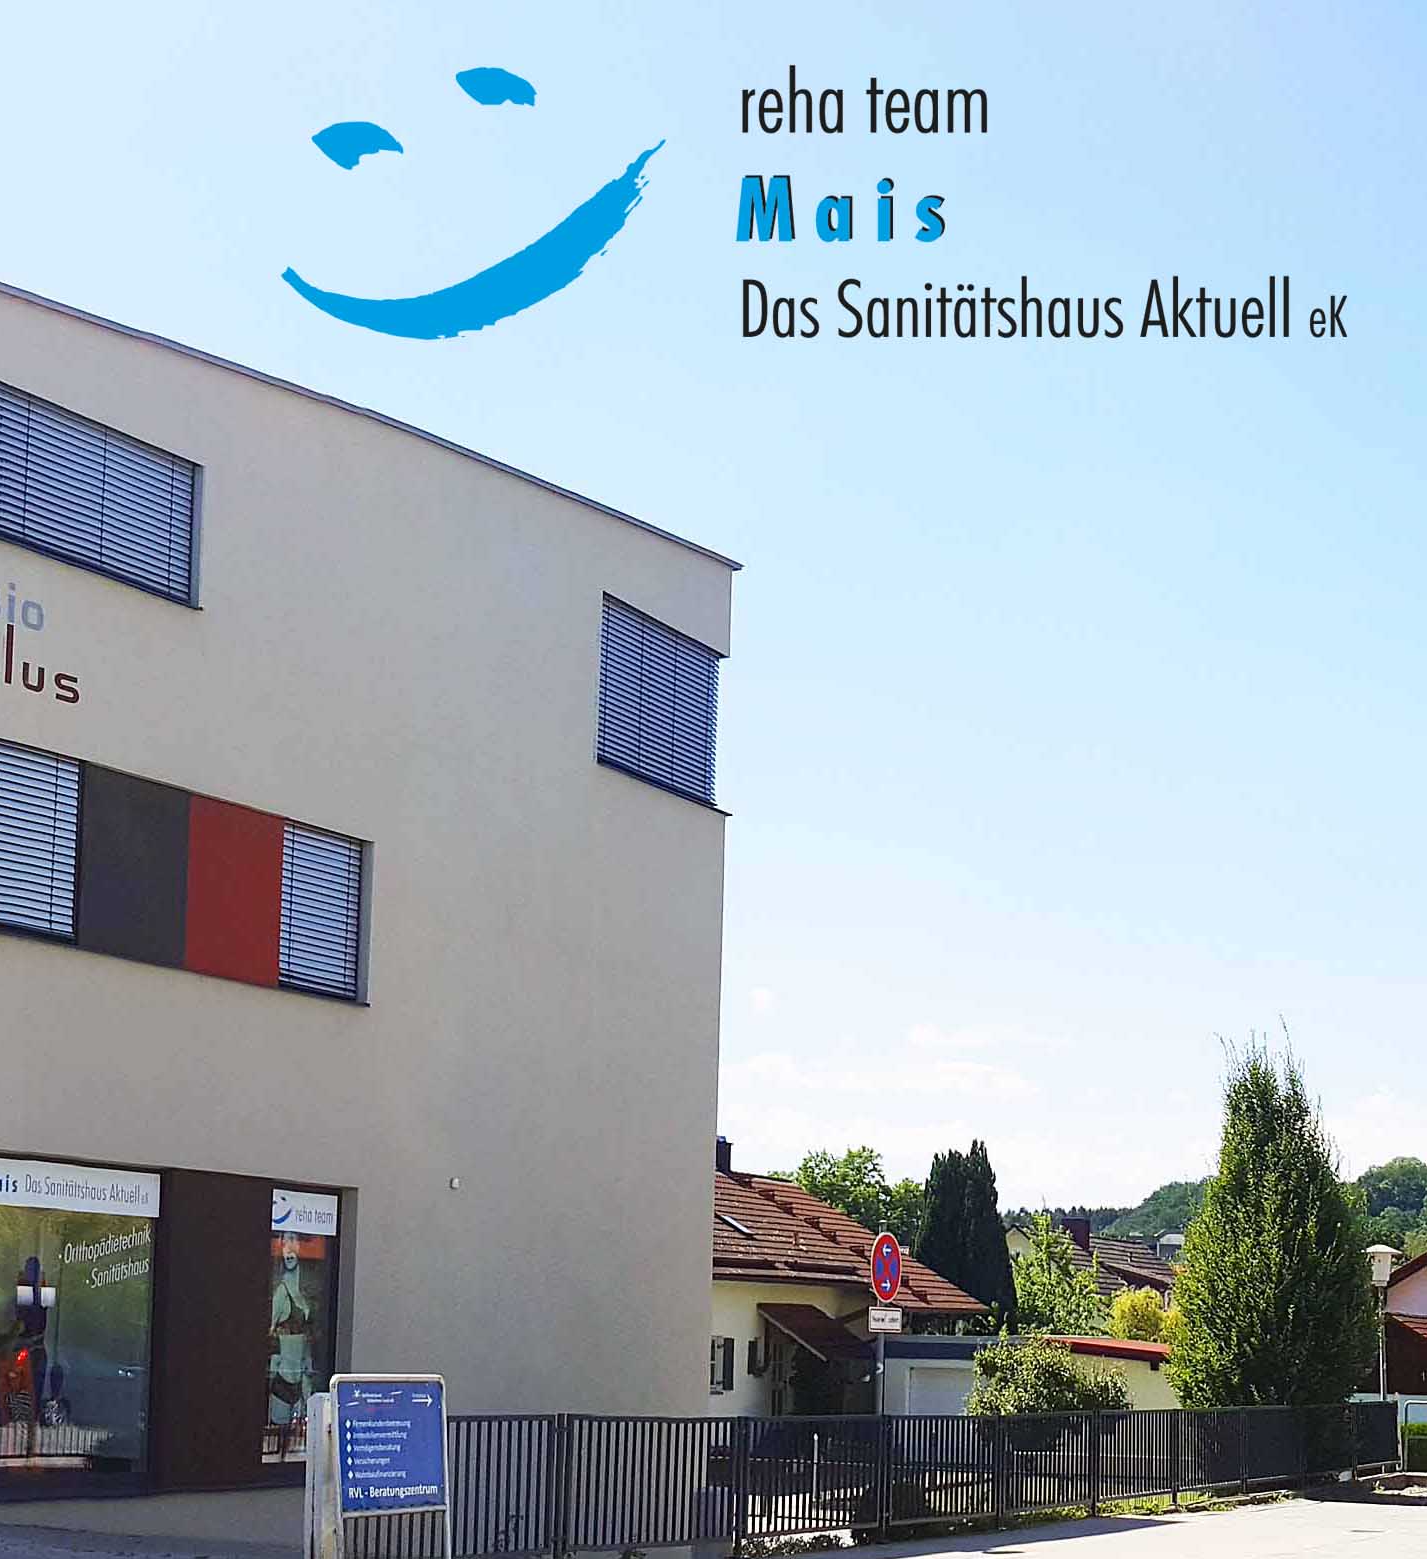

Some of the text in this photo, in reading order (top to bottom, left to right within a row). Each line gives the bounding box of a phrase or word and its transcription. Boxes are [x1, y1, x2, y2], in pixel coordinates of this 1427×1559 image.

[25, 1174, 42, 1194] Das
[44, 1176, 107, 1201] Sanitätshaus
[109, 1183, 140, 1206] Aktuell
[295, 1204, 333, 1225] reha team
[63, 1223, 152, 1265] Orthopädietechnik
[90, 1257, 150, 1289] Sanitätshaus
[349, 1487, 364, 1499] RVL
[369, 1484, 438, 1499] Beratungszentrum
